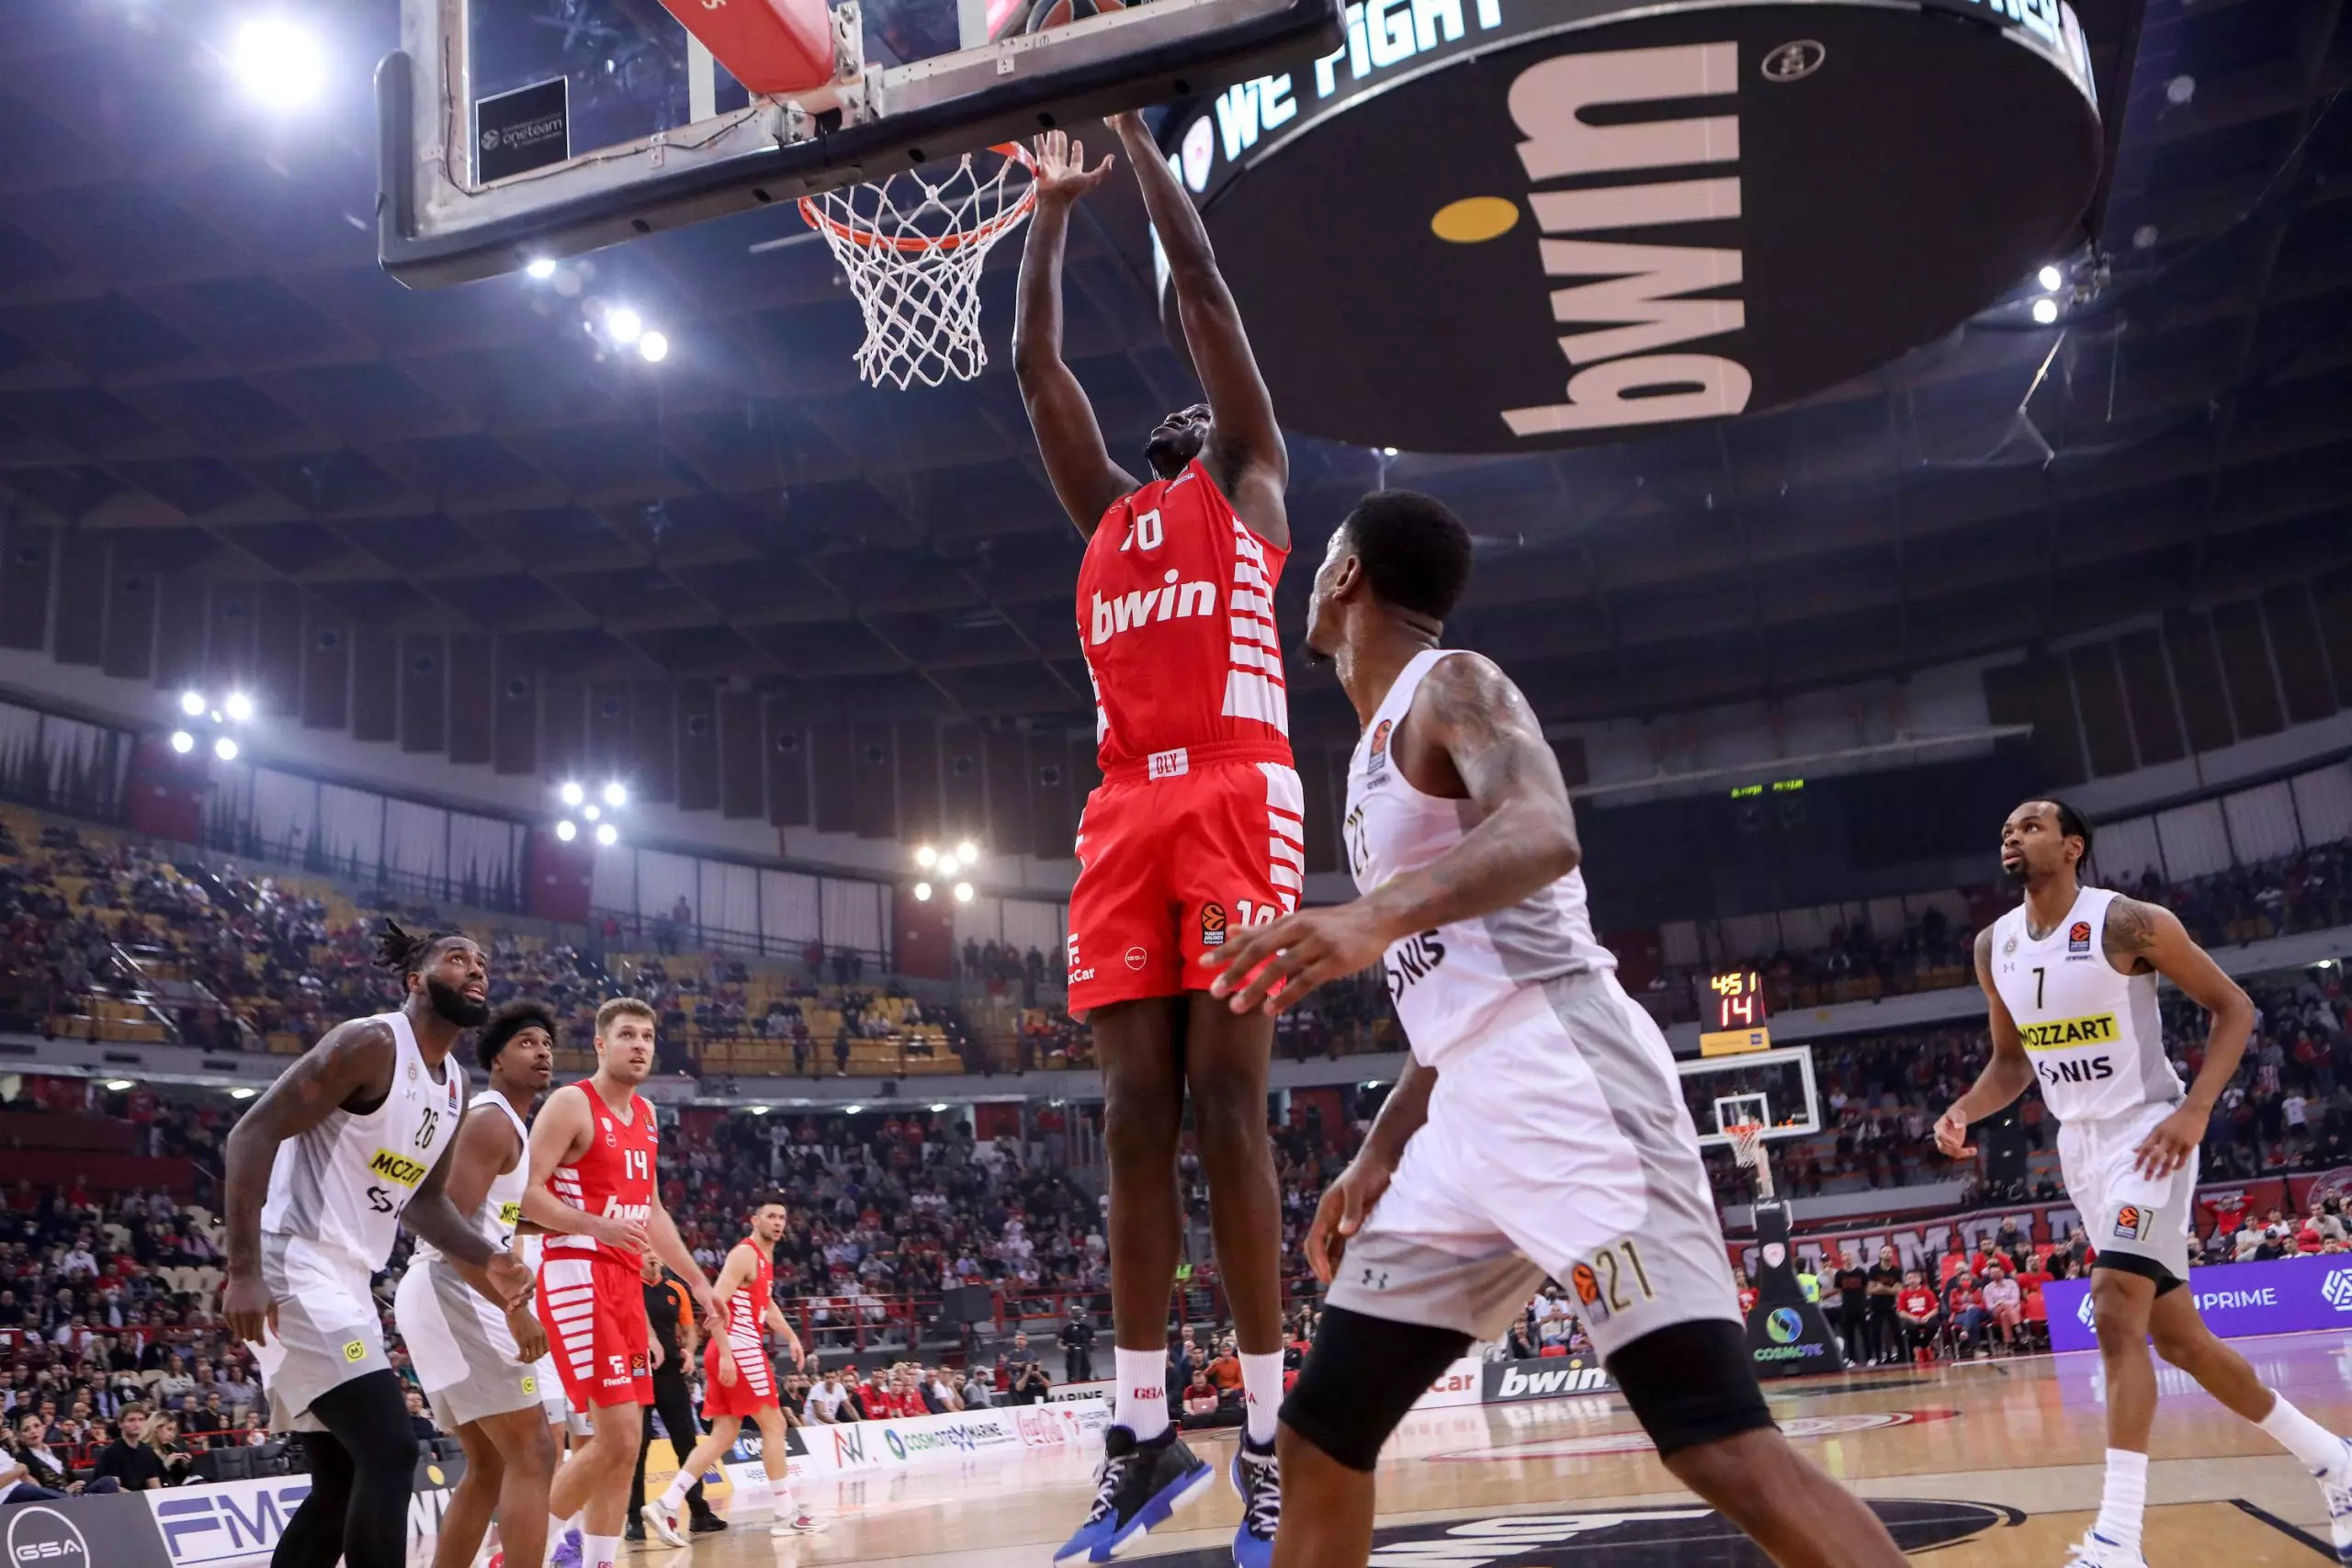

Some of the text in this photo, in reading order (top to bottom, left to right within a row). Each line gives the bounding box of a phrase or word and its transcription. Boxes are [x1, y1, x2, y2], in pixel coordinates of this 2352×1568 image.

[1216, 72, 1296, 162] WE
[1430, 40, 1753, 436] bwin
[1091, 569, 1216, 646] bwin
[1156, 753, 1177, 774] OLY
[1397, 928, 1445, 986] NIS
[2032, 967, 2045, 1009] 7
[1721, 995, 1753, 1027] 14
[2019, 1016, 2112, 1046] MOZZART
[2059, 1055, 2113, 1083] NIS
[414, 1107, 439, 1149] 26
[624, 1149, 649, 1180] 14
[2143, 1209, 2154, 1241] 7
[1596, 1240, 1653, 1313] 21
[2204, 1288, 2278, 1311] PRIME
[603, 1376, 632, 1388] FlexCa
[1134, 1386, 1164, 1400] GSA
[1498, 1359, 1608, 1397] bwin
[16, 1539, 83, 1561] GSA
